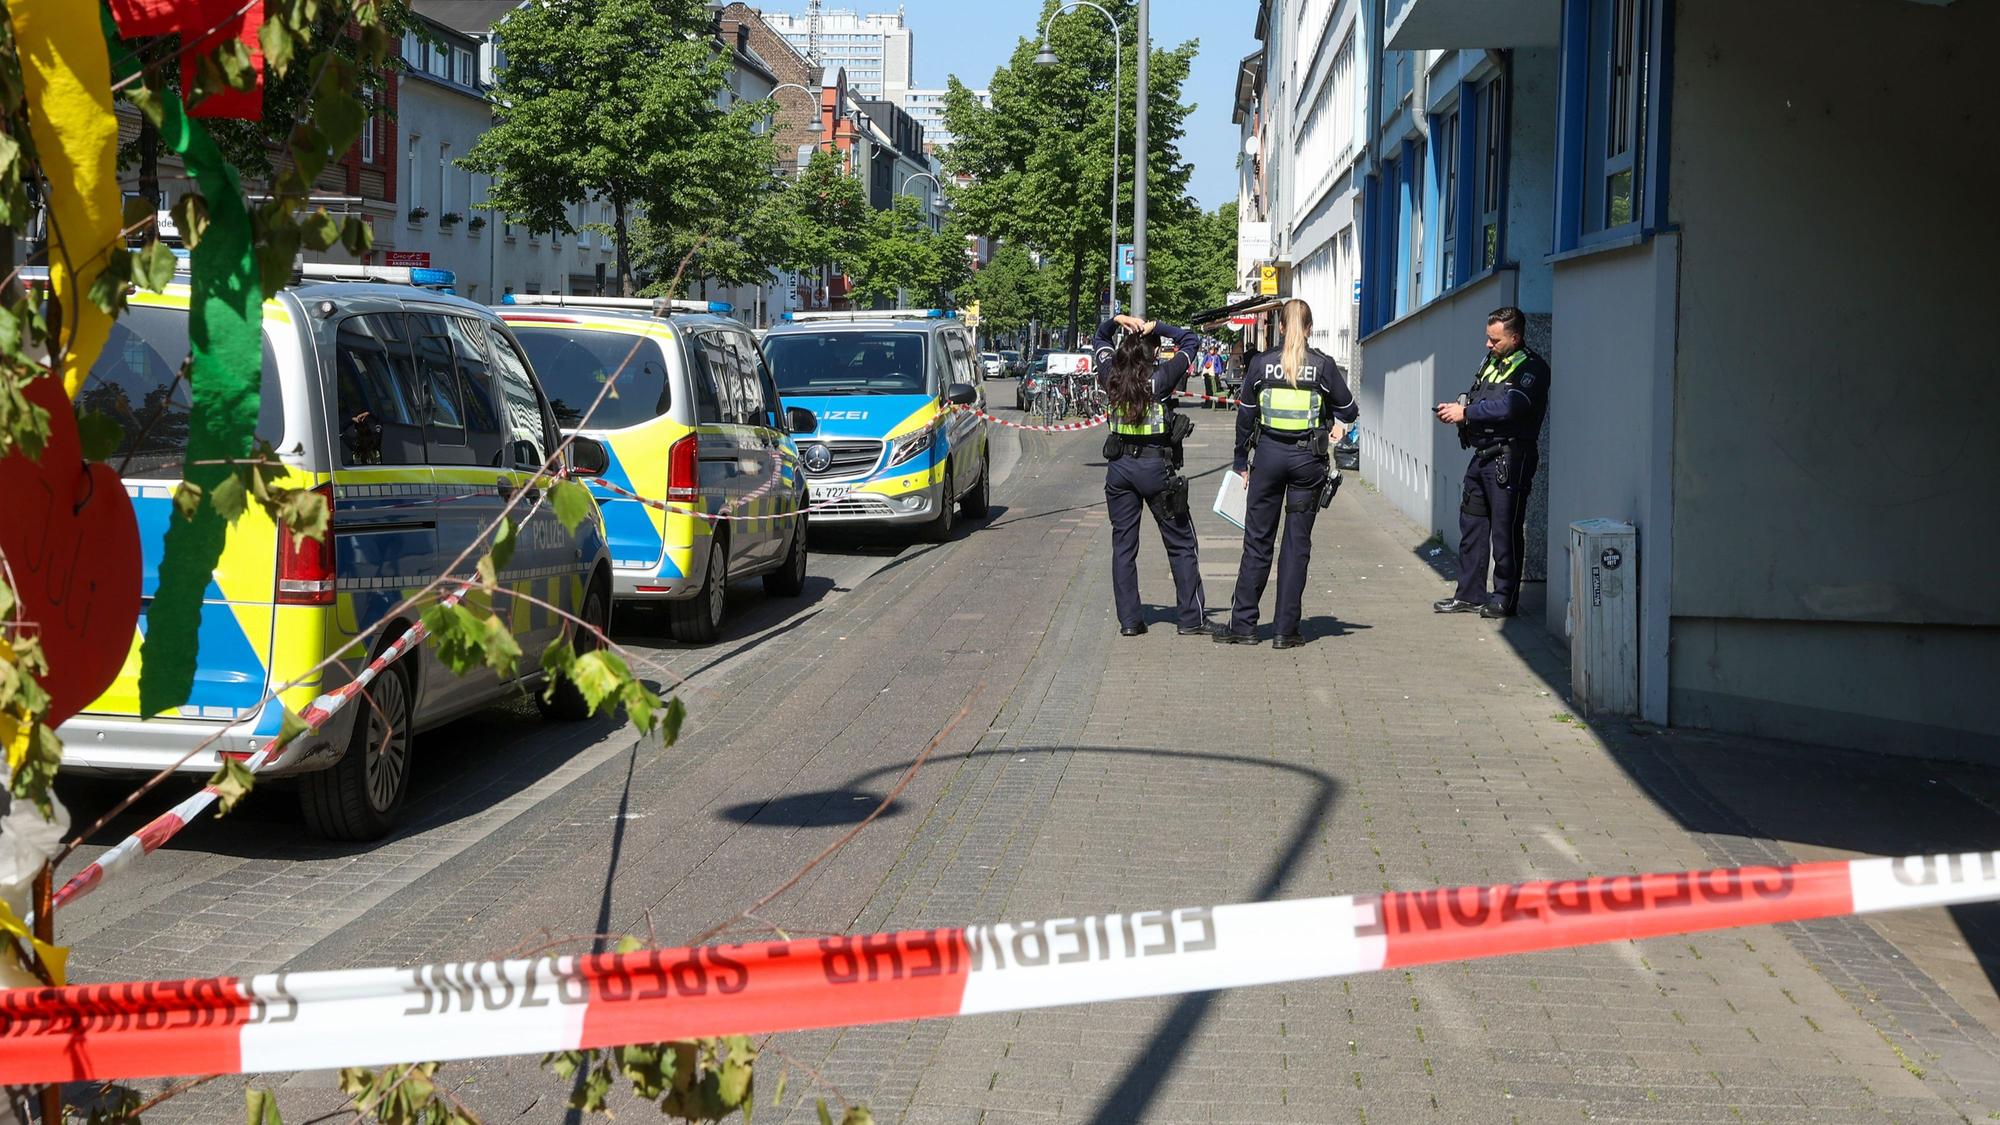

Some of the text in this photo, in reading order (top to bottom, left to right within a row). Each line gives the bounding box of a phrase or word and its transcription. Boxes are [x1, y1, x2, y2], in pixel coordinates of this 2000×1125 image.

[1265, 364, 1317, 382] POZEI
[812, 410, 869, 420] LIZEI
[532, 519, 565, 550] POLIZEI
